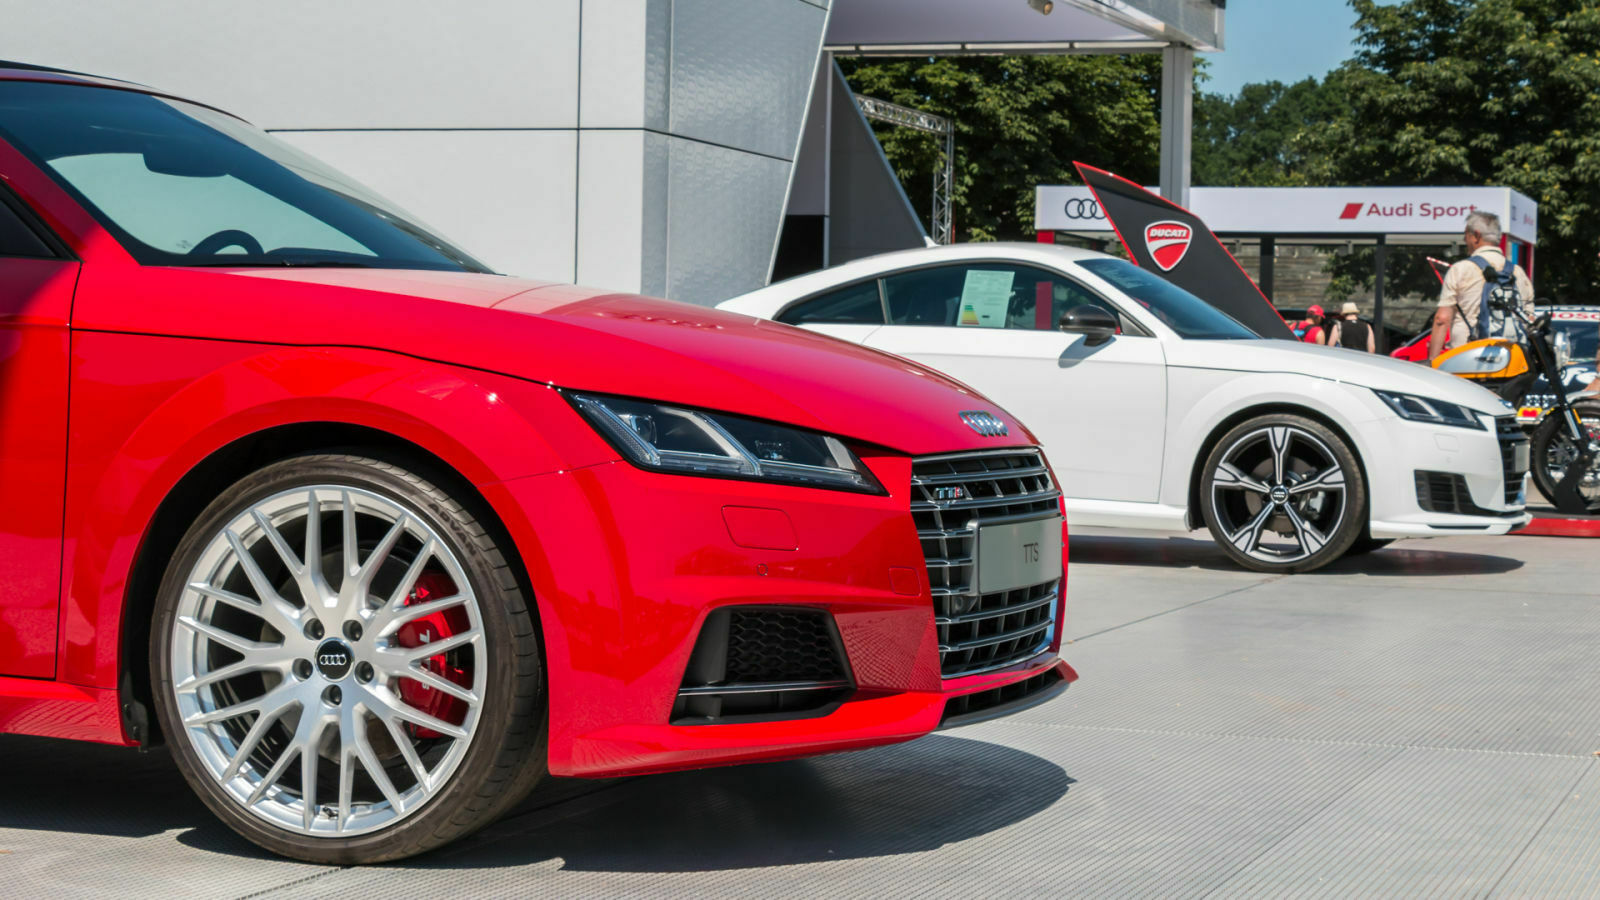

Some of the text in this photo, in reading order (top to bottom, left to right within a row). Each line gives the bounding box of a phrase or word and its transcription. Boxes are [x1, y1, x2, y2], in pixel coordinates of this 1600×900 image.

[1366, 202, 1478, 220] Audi Sport
[1150, 228, 1188, 238] DUCATI
[427, 502, 478, 557] ADVAN
[1023, 542, 1039, 564] TTS
